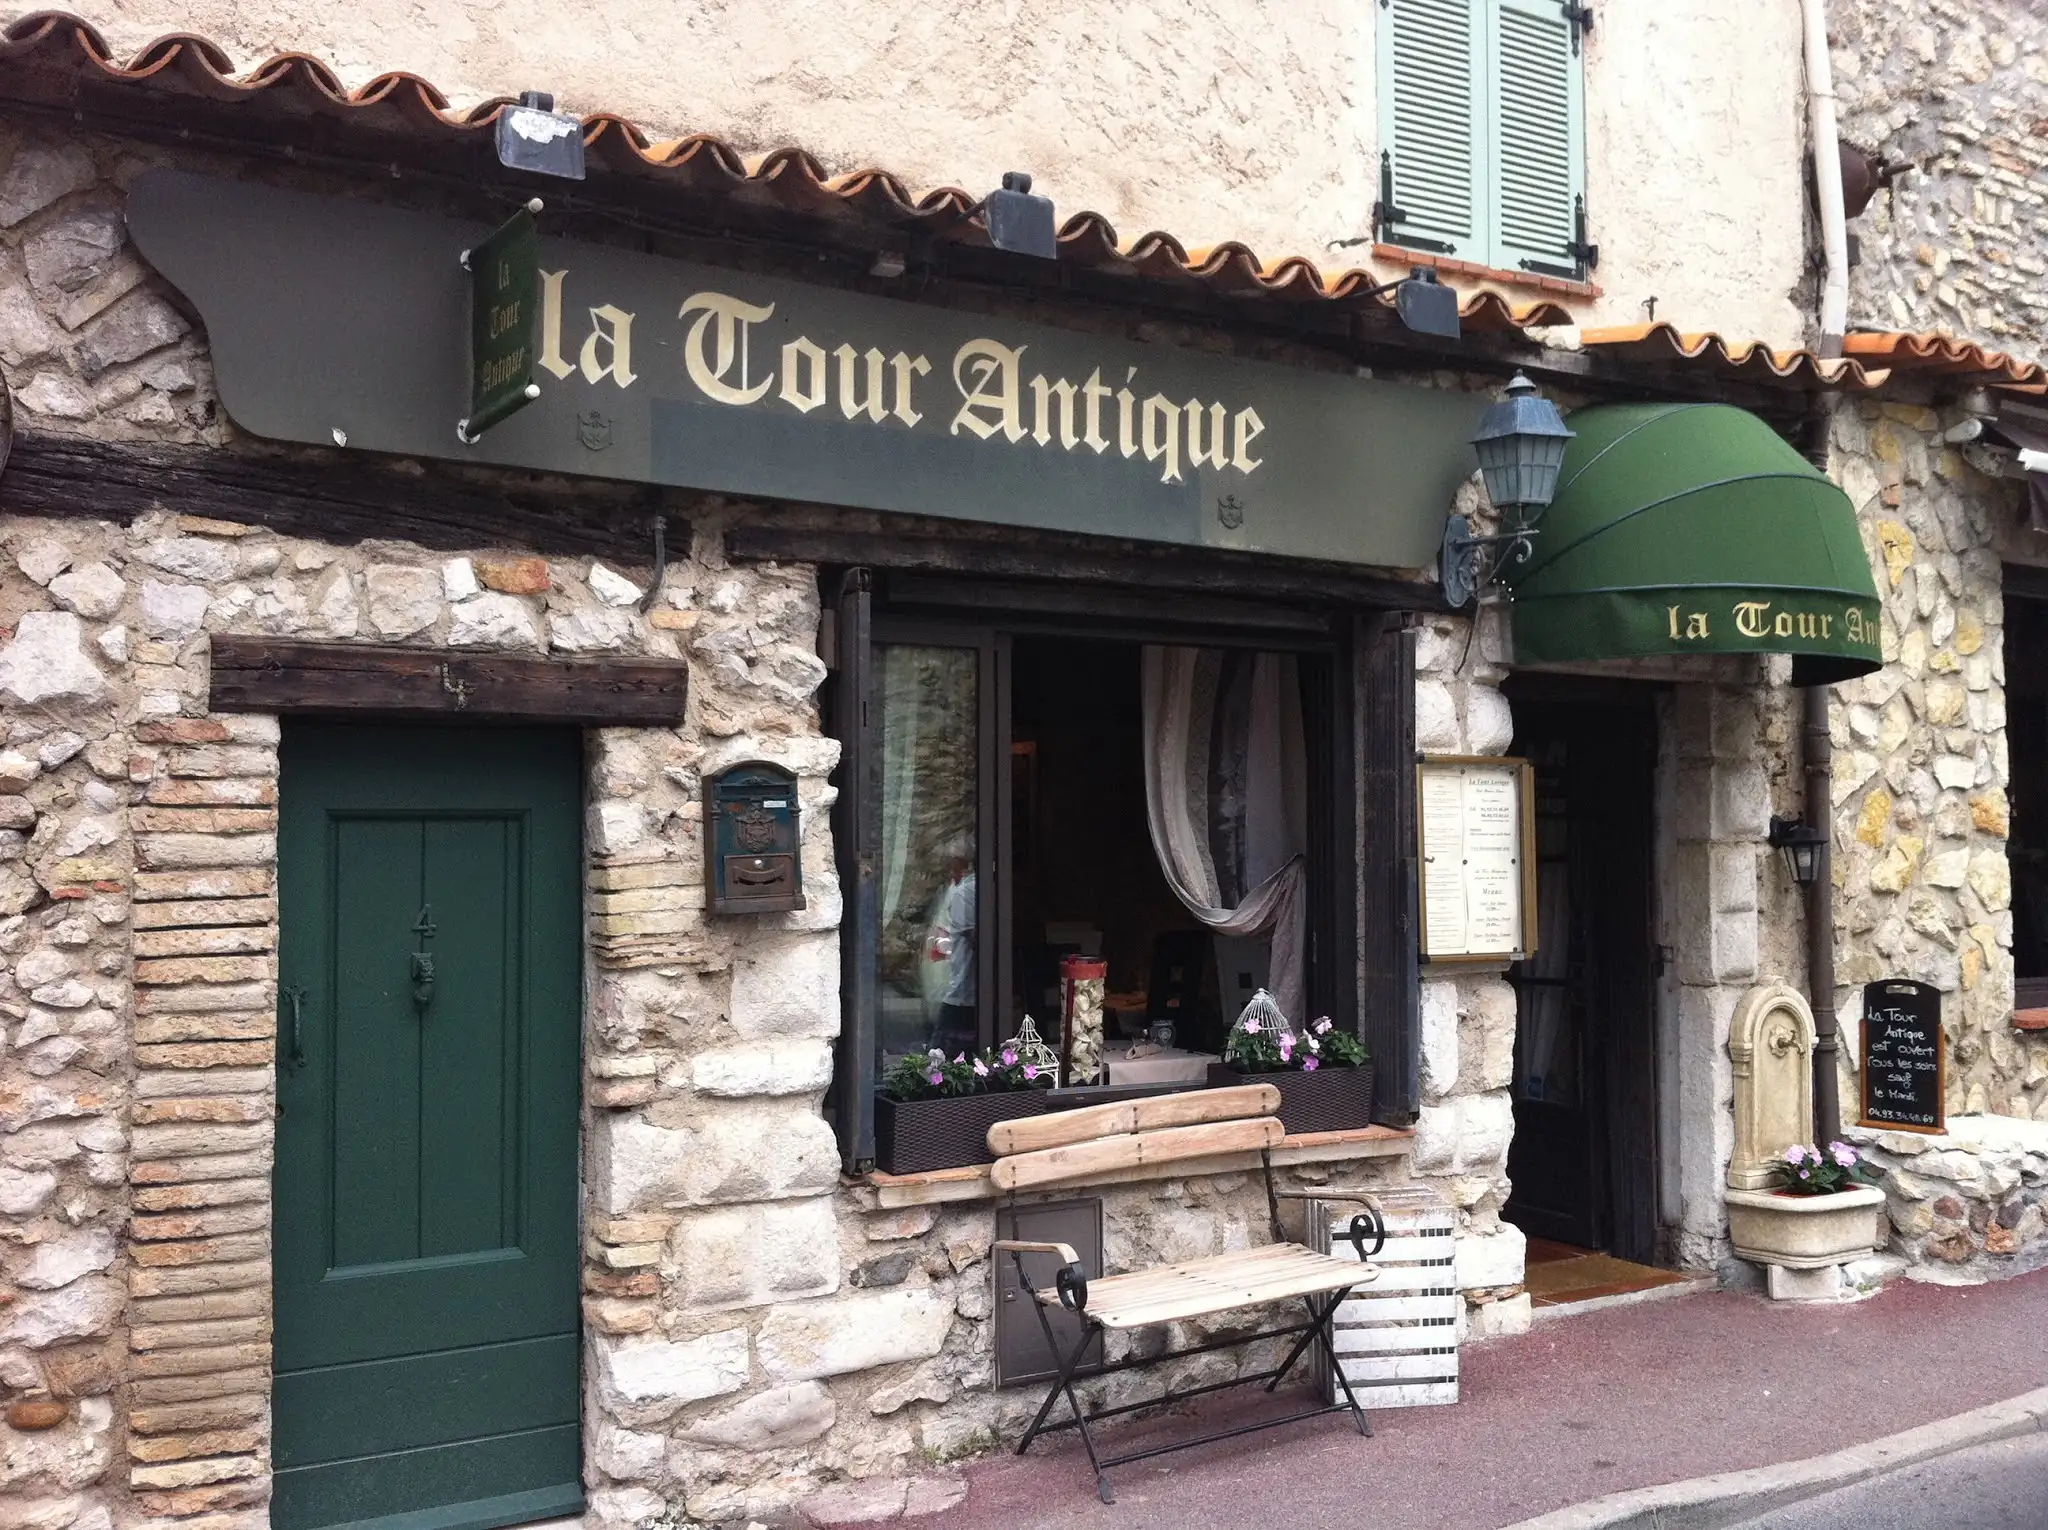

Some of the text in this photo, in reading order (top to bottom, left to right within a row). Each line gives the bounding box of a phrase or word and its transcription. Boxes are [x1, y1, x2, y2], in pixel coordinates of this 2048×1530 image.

[489, 299, 521, 341] Tour
[482, 346, 526, 394] Antique
[537, 268, 1265, 484] la Tour Antique
[1666, 604, 1710, 640] la
[1732, 601, 1833, 640] Tour
[411, 903, 437, 938] 4
[1867, 1006, 1918, 1023] La Tour
[1884, 1024, 1926, 1045] Antique
[1871, 1040, 1936, 1057] est ouvert
[1897, 1058, 1913, 1070] les
[1887, 1072, 1912, 1090] sauf
[1874, 1086, 1885, 1099] le
